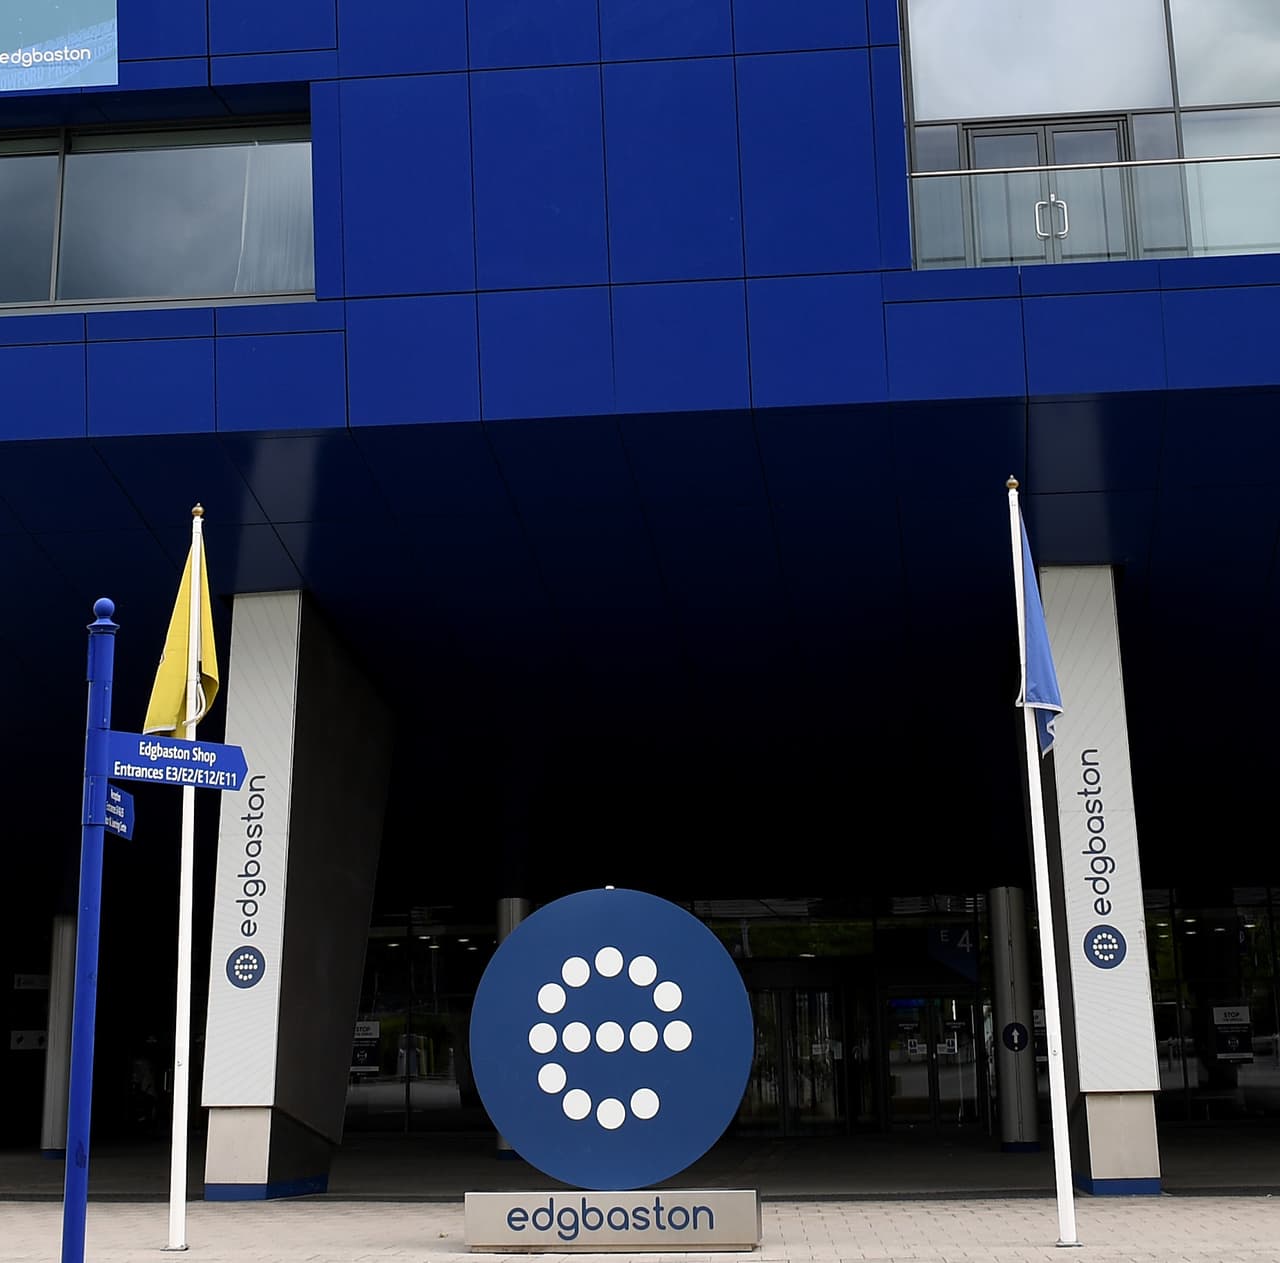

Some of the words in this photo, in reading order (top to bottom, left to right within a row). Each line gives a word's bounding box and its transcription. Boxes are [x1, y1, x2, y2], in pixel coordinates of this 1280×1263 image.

[0, 46, 91, 67] edgbaston
[139, 741, 190, 761] Edgbaston
[192, 747, 217, 766] Shop
[114, 761, 163, 780] Entrances
[166, 767, 237, 786] E3/E2/E12/E11
[1077, 749, 1115, 915] edgbaston
[236, 775, 266, 937] edgbaston
[507, 1196, 714, 1240] edgbaston
